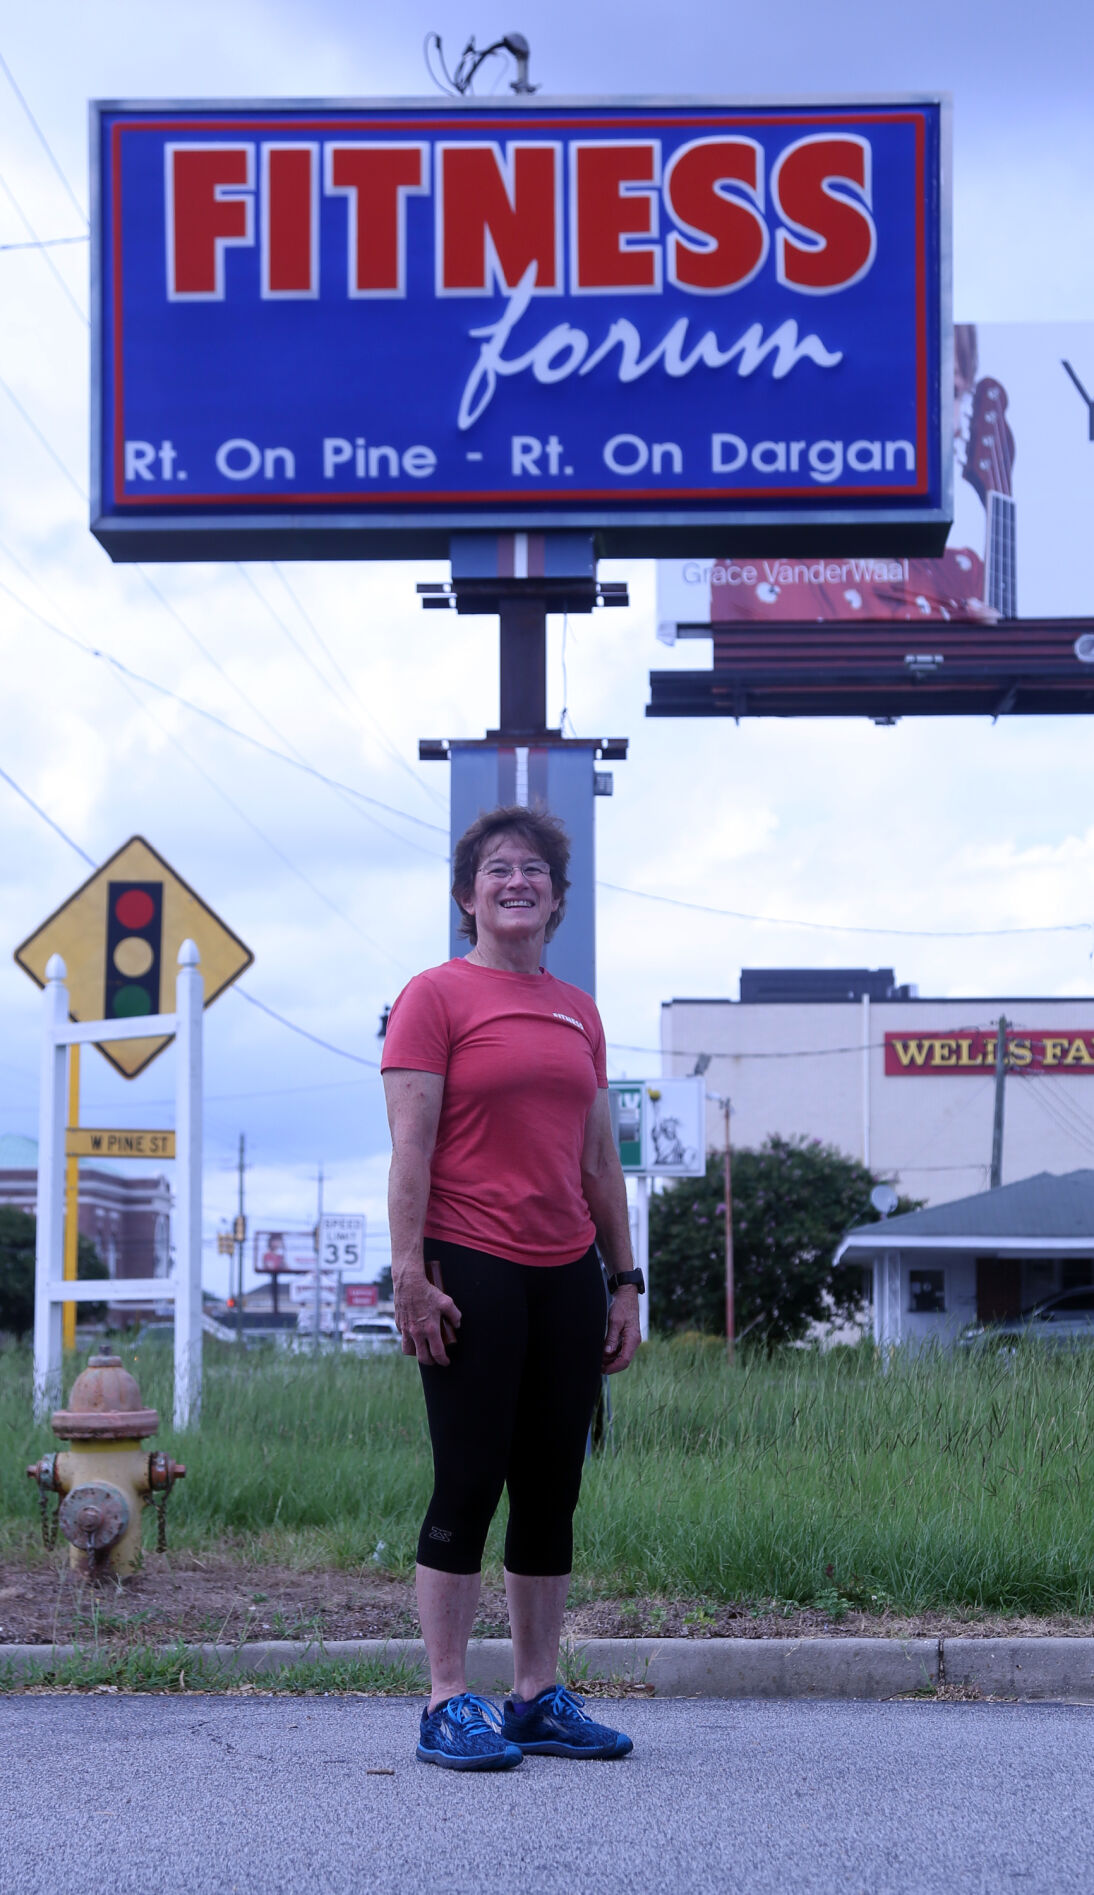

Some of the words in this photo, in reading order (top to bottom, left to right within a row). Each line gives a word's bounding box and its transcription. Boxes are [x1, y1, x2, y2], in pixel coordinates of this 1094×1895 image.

[164, 132, 877, 302] FITNESS
[458, 259, 842, 430] forum
[125, 440, 187, 481] Rt.
[215, 438, 295, 480] On
[324, 438, 437, 479] Pine
[511, 435, 574, 476] Rt.
[603, 434, 683, 475] On
[711, 433, 915, 482] Dargan
[682, 561, 757, 586] Grace
[763, 558, 910, 584] VanderWaal
[1041, 1038, 1094, 1066] FA
[90, 1134, 102, 1151] W
[107, 1135, 145, 1153] PINE
[149, 1136, 168, 1154] ST
[324, 1243, 359, 1265] 35
